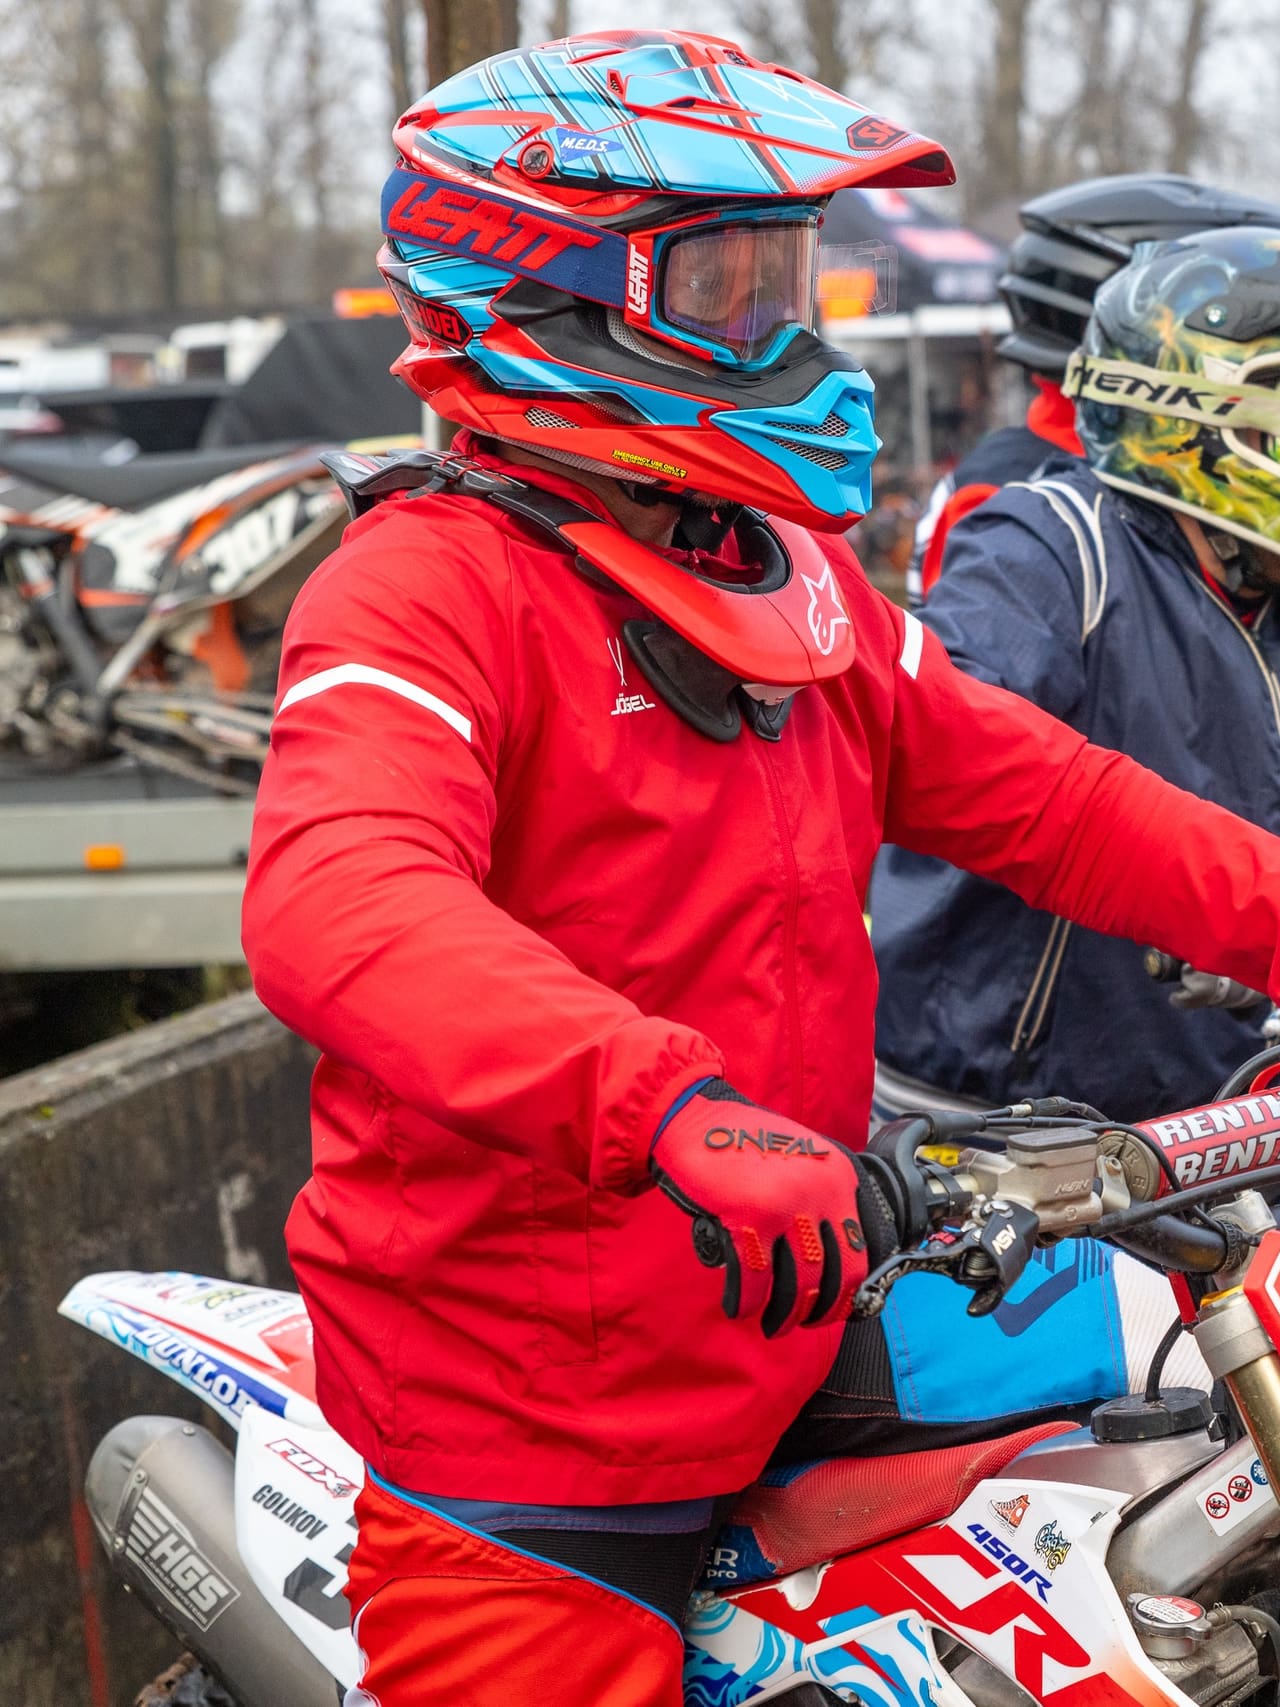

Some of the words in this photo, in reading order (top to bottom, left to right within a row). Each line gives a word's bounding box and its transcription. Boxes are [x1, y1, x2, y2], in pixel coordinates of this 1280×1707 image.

[560, 137, 609, 153] M.E.D.S.
[388, 181, 603, 271] LEATT
[627, 243, 650, 315] LEATT
[251, 1484, 329, 1541] GOLIKOV
[150, 1532, 229, 1613] HGS
[706, 1569, 738, 1580] pro
[966, 1523, 1054, 1605] 450R
